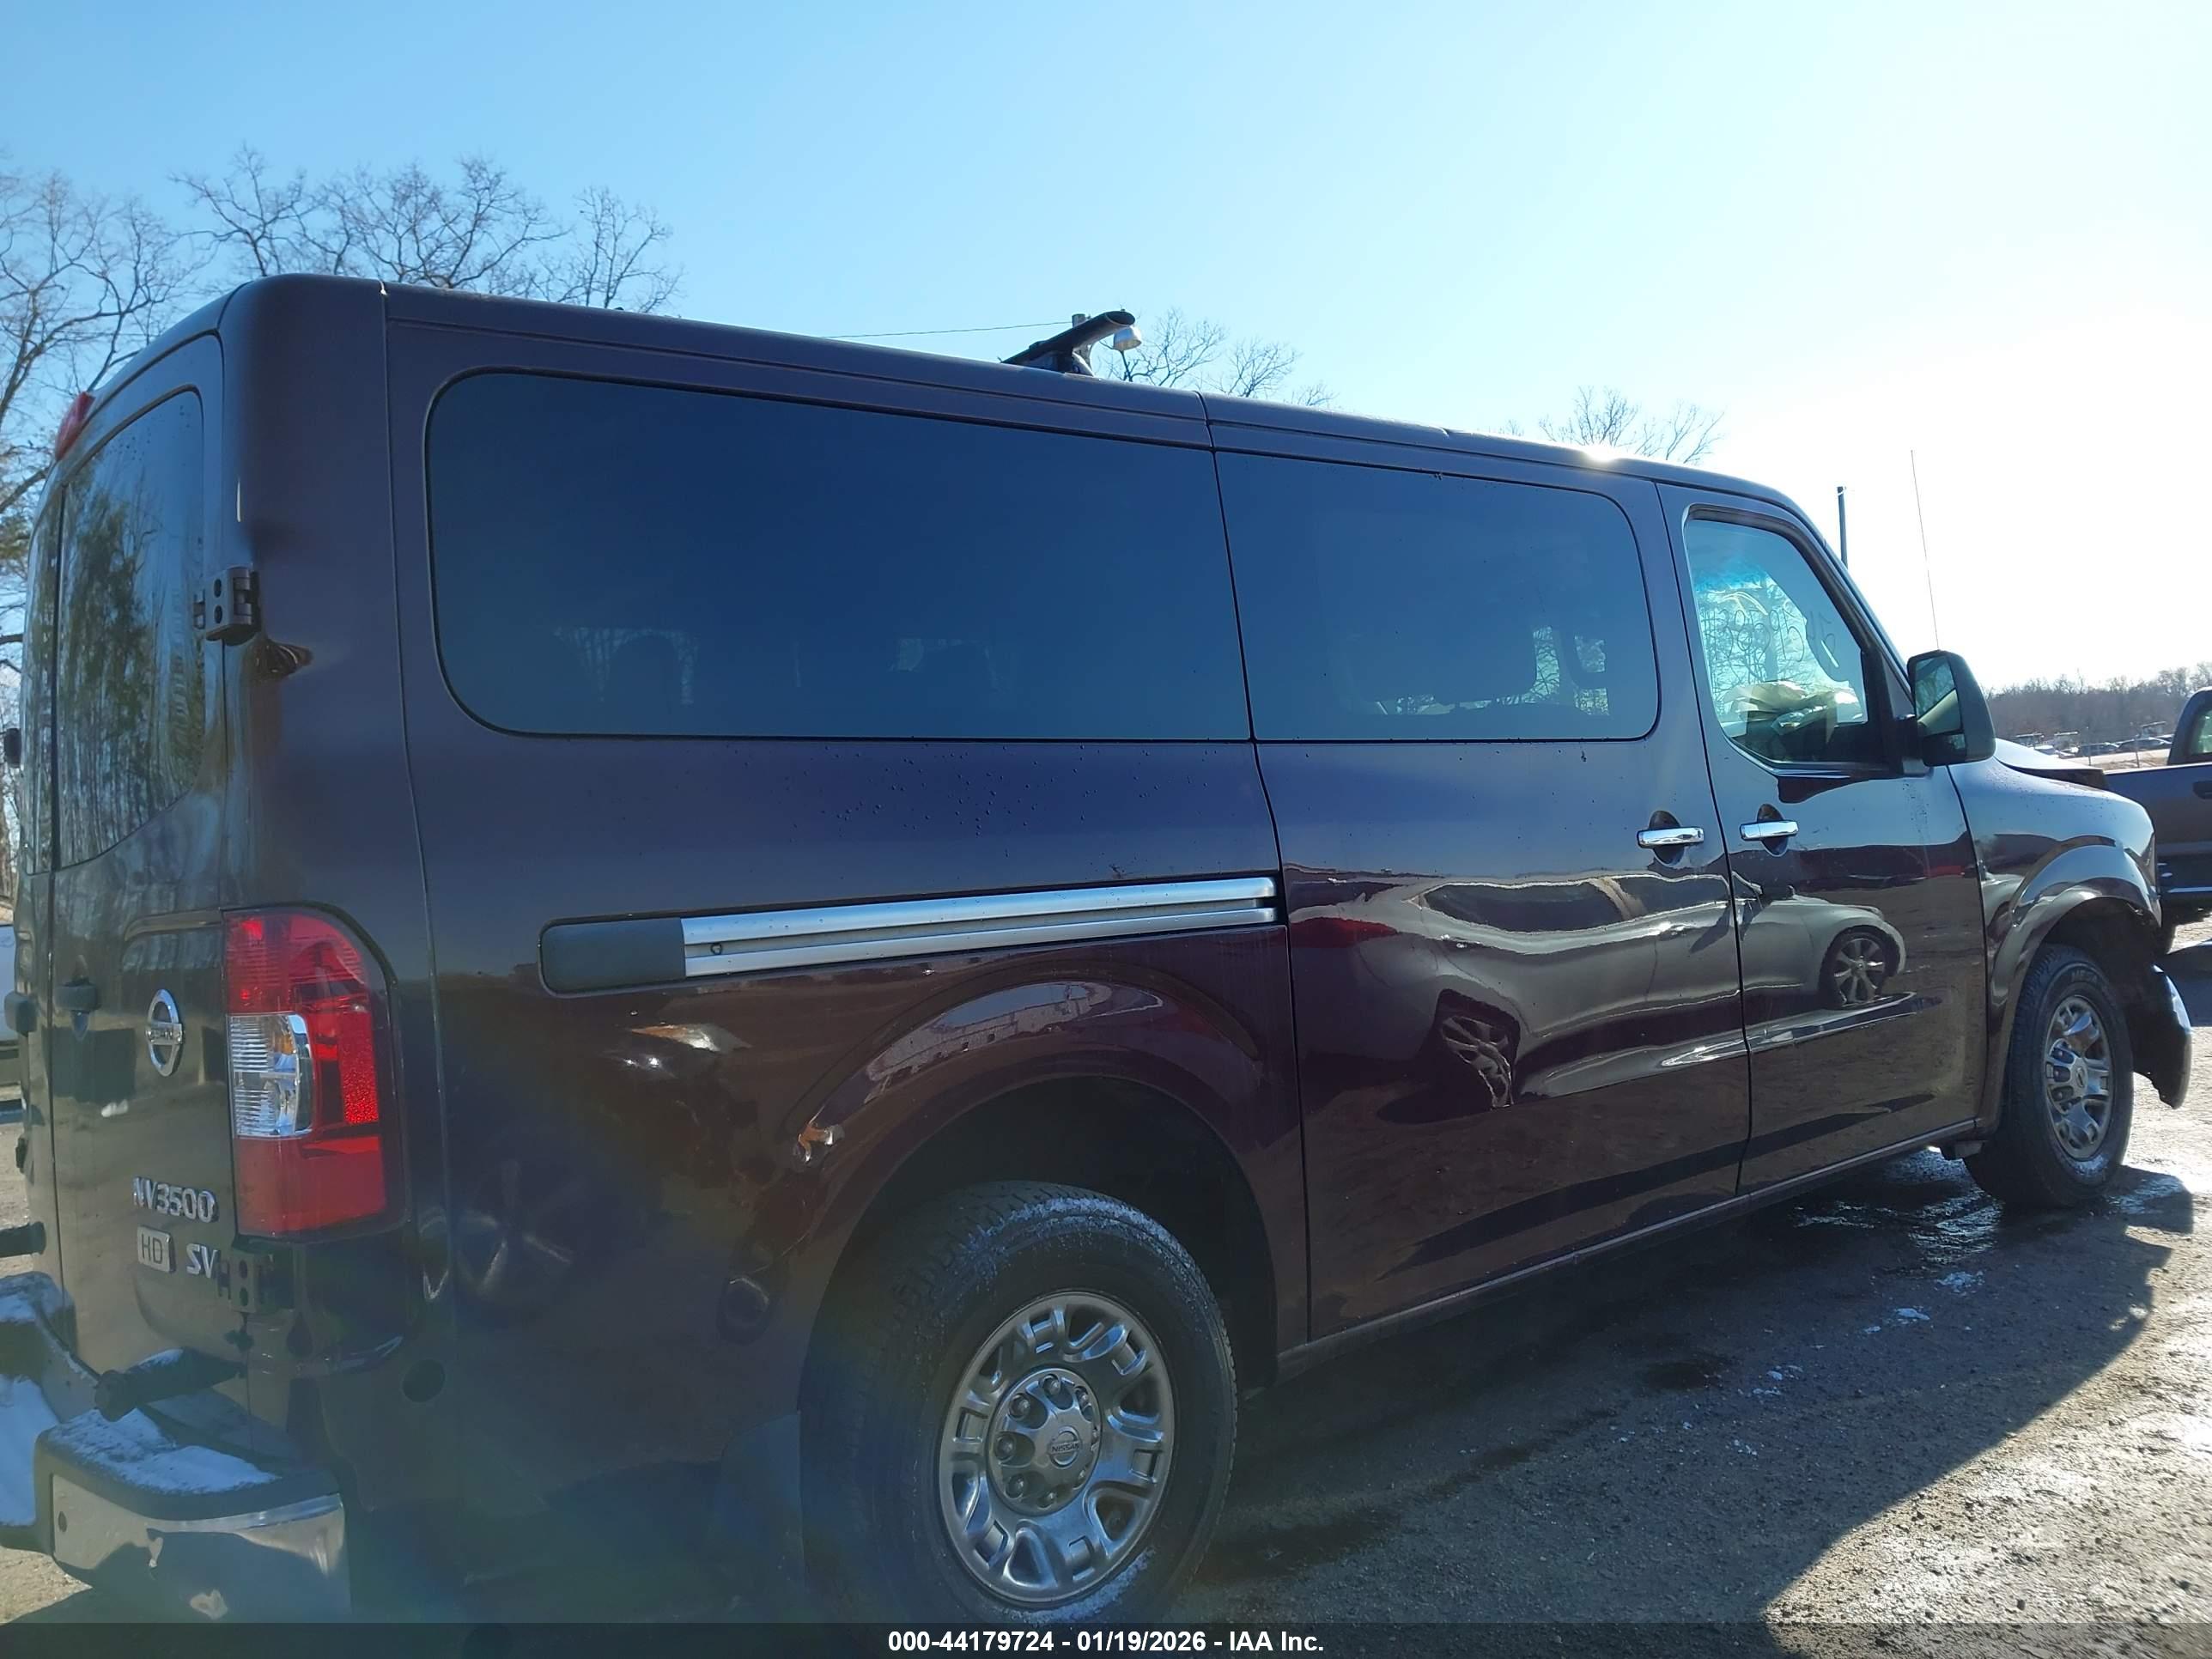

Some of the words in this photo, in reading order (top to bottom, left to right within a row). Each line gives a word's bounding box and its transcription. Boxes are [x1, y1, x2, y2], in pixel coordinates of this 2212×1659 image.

[132, 1176, 216, 1223] NV3500
[141, 1232, 163, 1265] HD
[185, 1243, 218, 1279] SV
